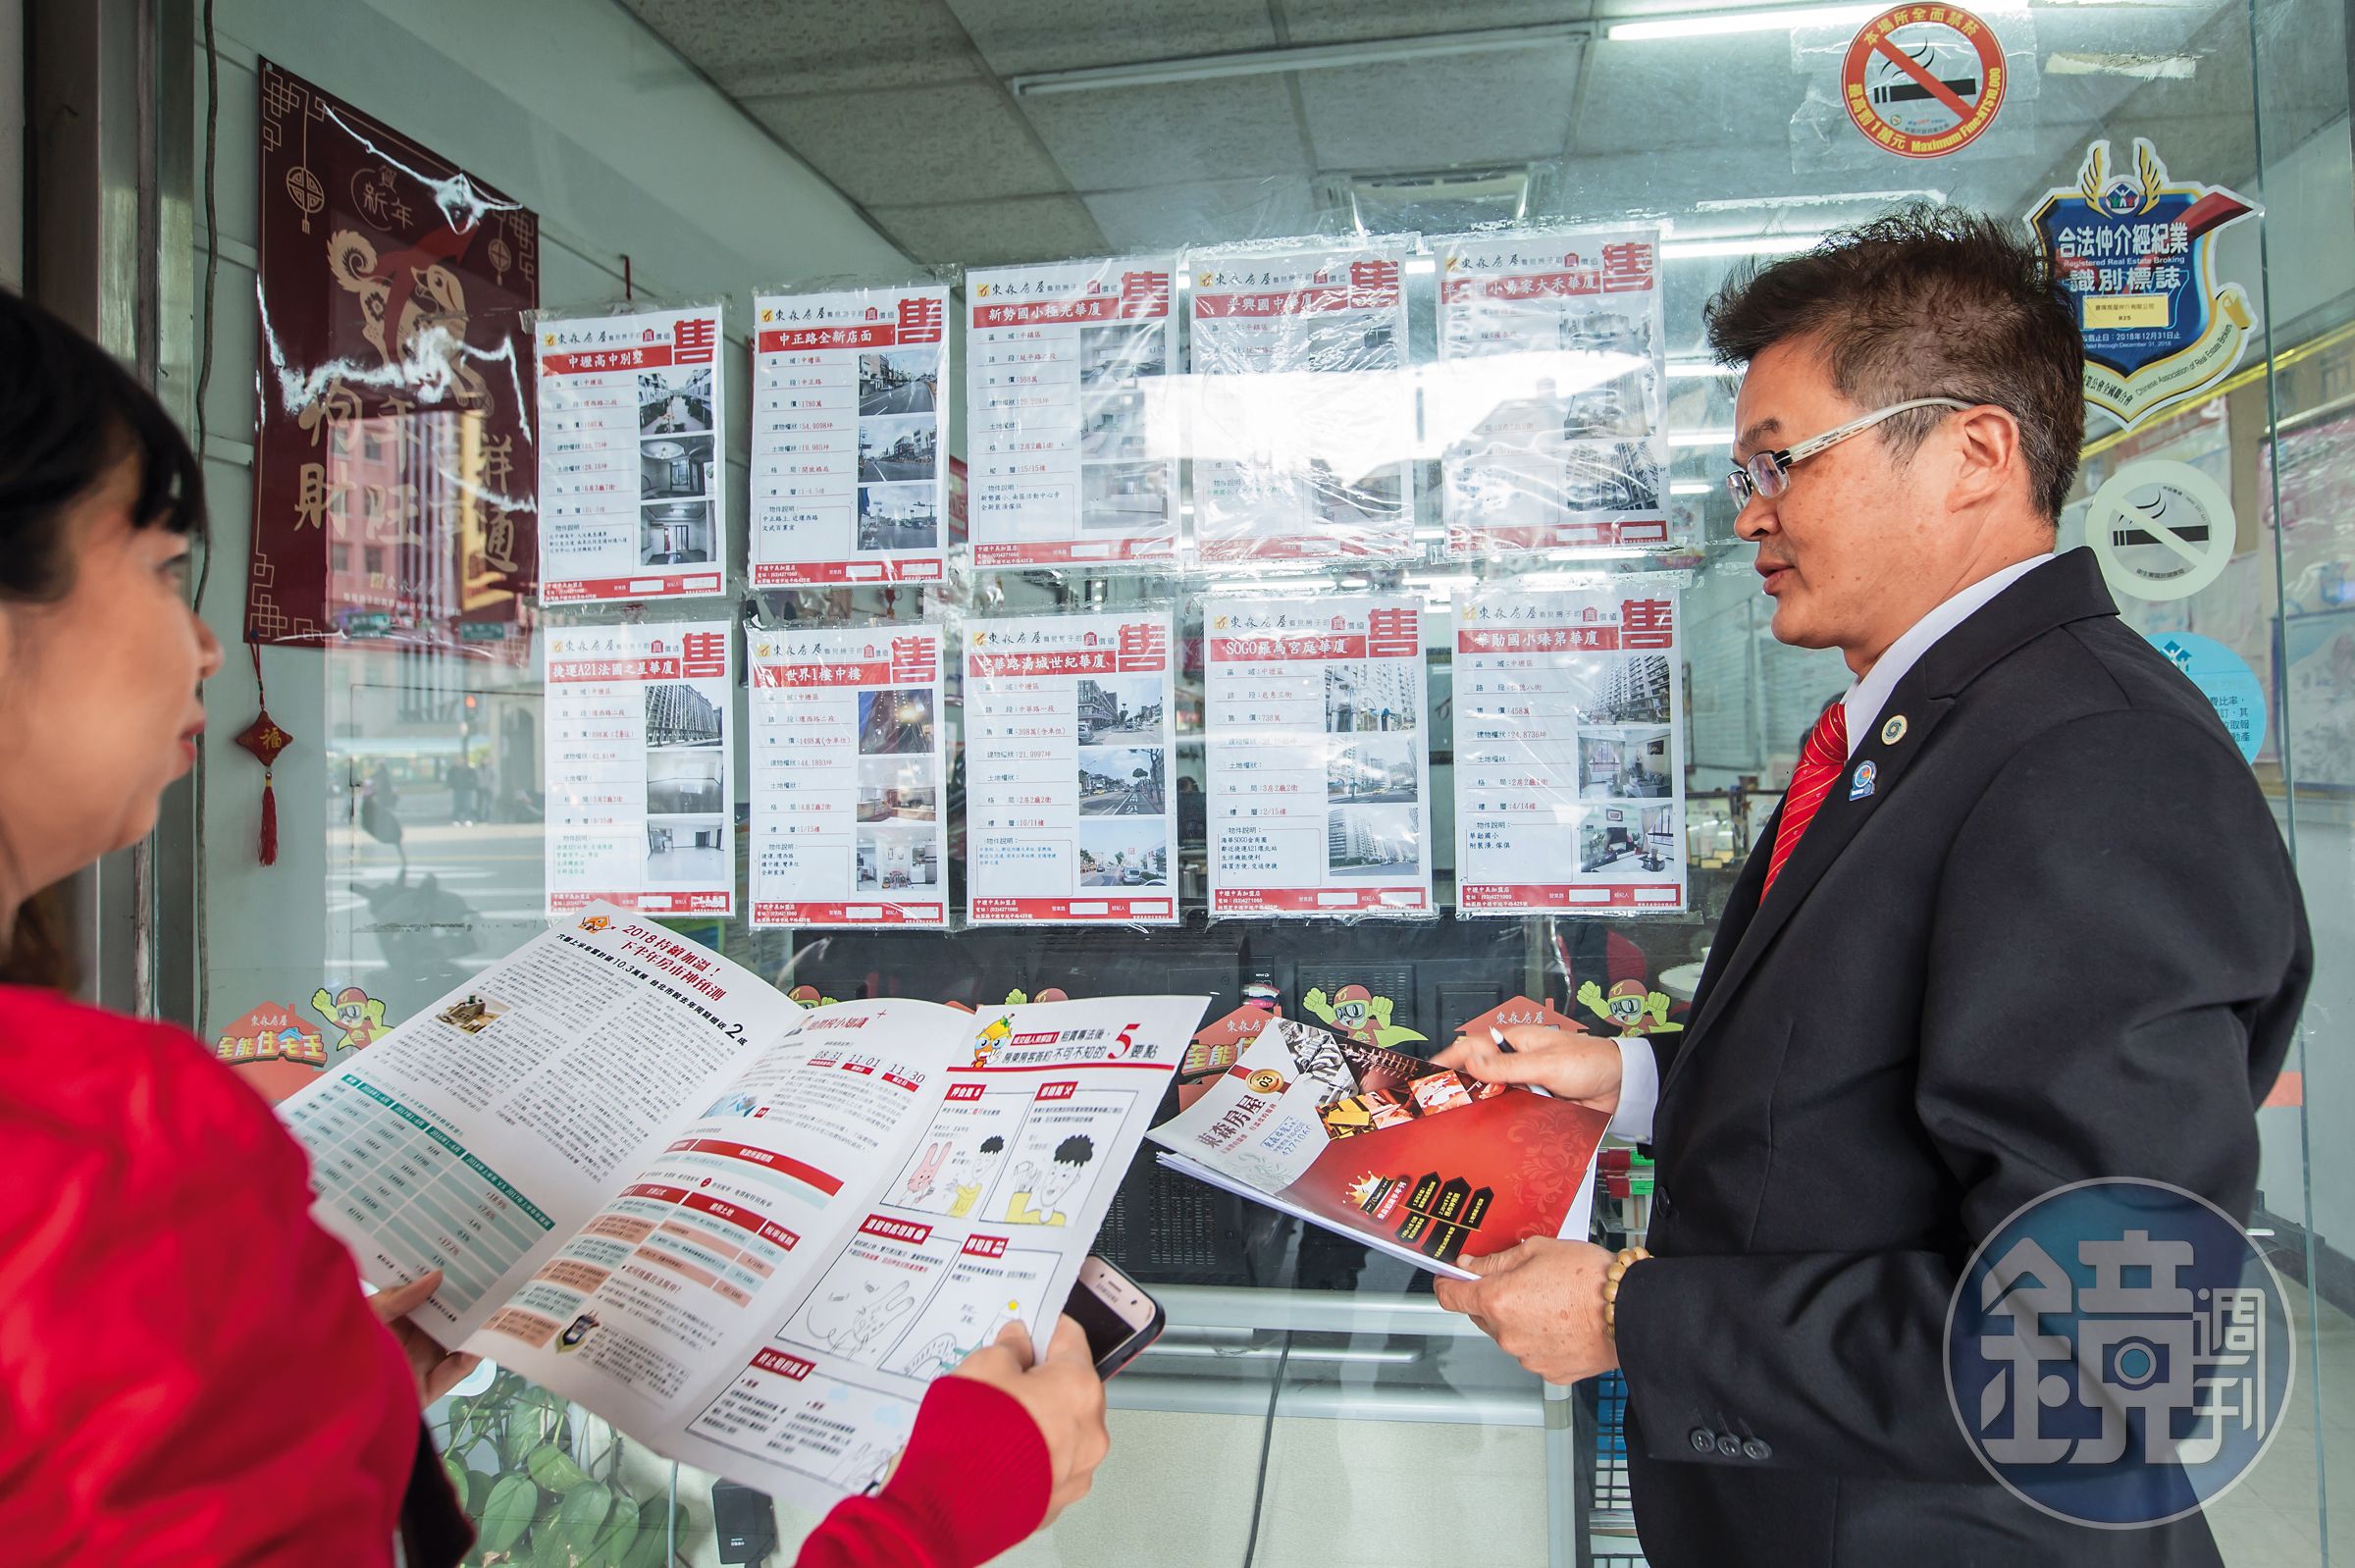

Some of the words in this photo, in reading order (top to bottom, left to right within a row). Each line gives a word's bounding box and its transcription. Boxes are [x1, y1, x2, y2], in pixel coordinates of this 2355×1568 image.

[1911, 129, 1962, 152] Maximum
[2058, 222, 2189, 258] 合法仲介經紀業
[1602, 242, 1653, 292] 售
[2064, 259, 2106, 269] Registered
[2108, 258, 2126, 267] Real
[2127, 256, 2152, 266] Estate
[2154, 255, 2185, 265] Broking
[992, 281, 1045, 295] 東森房屋
[2069, 266, 2181, 291] 識別標誌
[1122, 271, 1169, 318] 售
[776, 307, 824, 322] 東森房屋
[898, 297, 942, 344] 售
[988, 301, 1102, 321] 新勢國小極光華廈
[558, 331, 606, 344] 東森房屋
[674, 319, 715, 365] 售
[779, 330, 872, 345] 中正路全新店面
[568, 350, 644, 369] 中壢高中別墅
[2159, 366, 2192, 384] Association
[2195, 355, 2208, 368] Real
[1230, 615, 1287, 629] 東森房屋
[1480, 606, 1538, 620] 東森房屋
[1368, 608, 1418, 657] 售
[1621, 599, 1672, 650] 售
[565, 639, 613, 653] 東森房屋
[988, 631, 1040, 645] 東森房屋
[1118, 623, 1166, 672] 售
[682, 632, 724, 678] 售
[773, 643, 823, 656] 東森房屋
[891, 636, 935, 684] 售
[553, 660, 675, 678] 捷運A21法國之星華廈
[785, 667, 862, 682] 世界1樓中樓
[259, 728, 282, 750] 福
[621, 940, 727, 1002] 下半年房市神預測
[1495, 1011, 1544, 1025] 東森房屋
[217, 1030, 325, 1060] 全能住宅王
[1259, 1075, 1273, 1088] 03
[1196, 1094, 1266, 1149] 東森房屋
